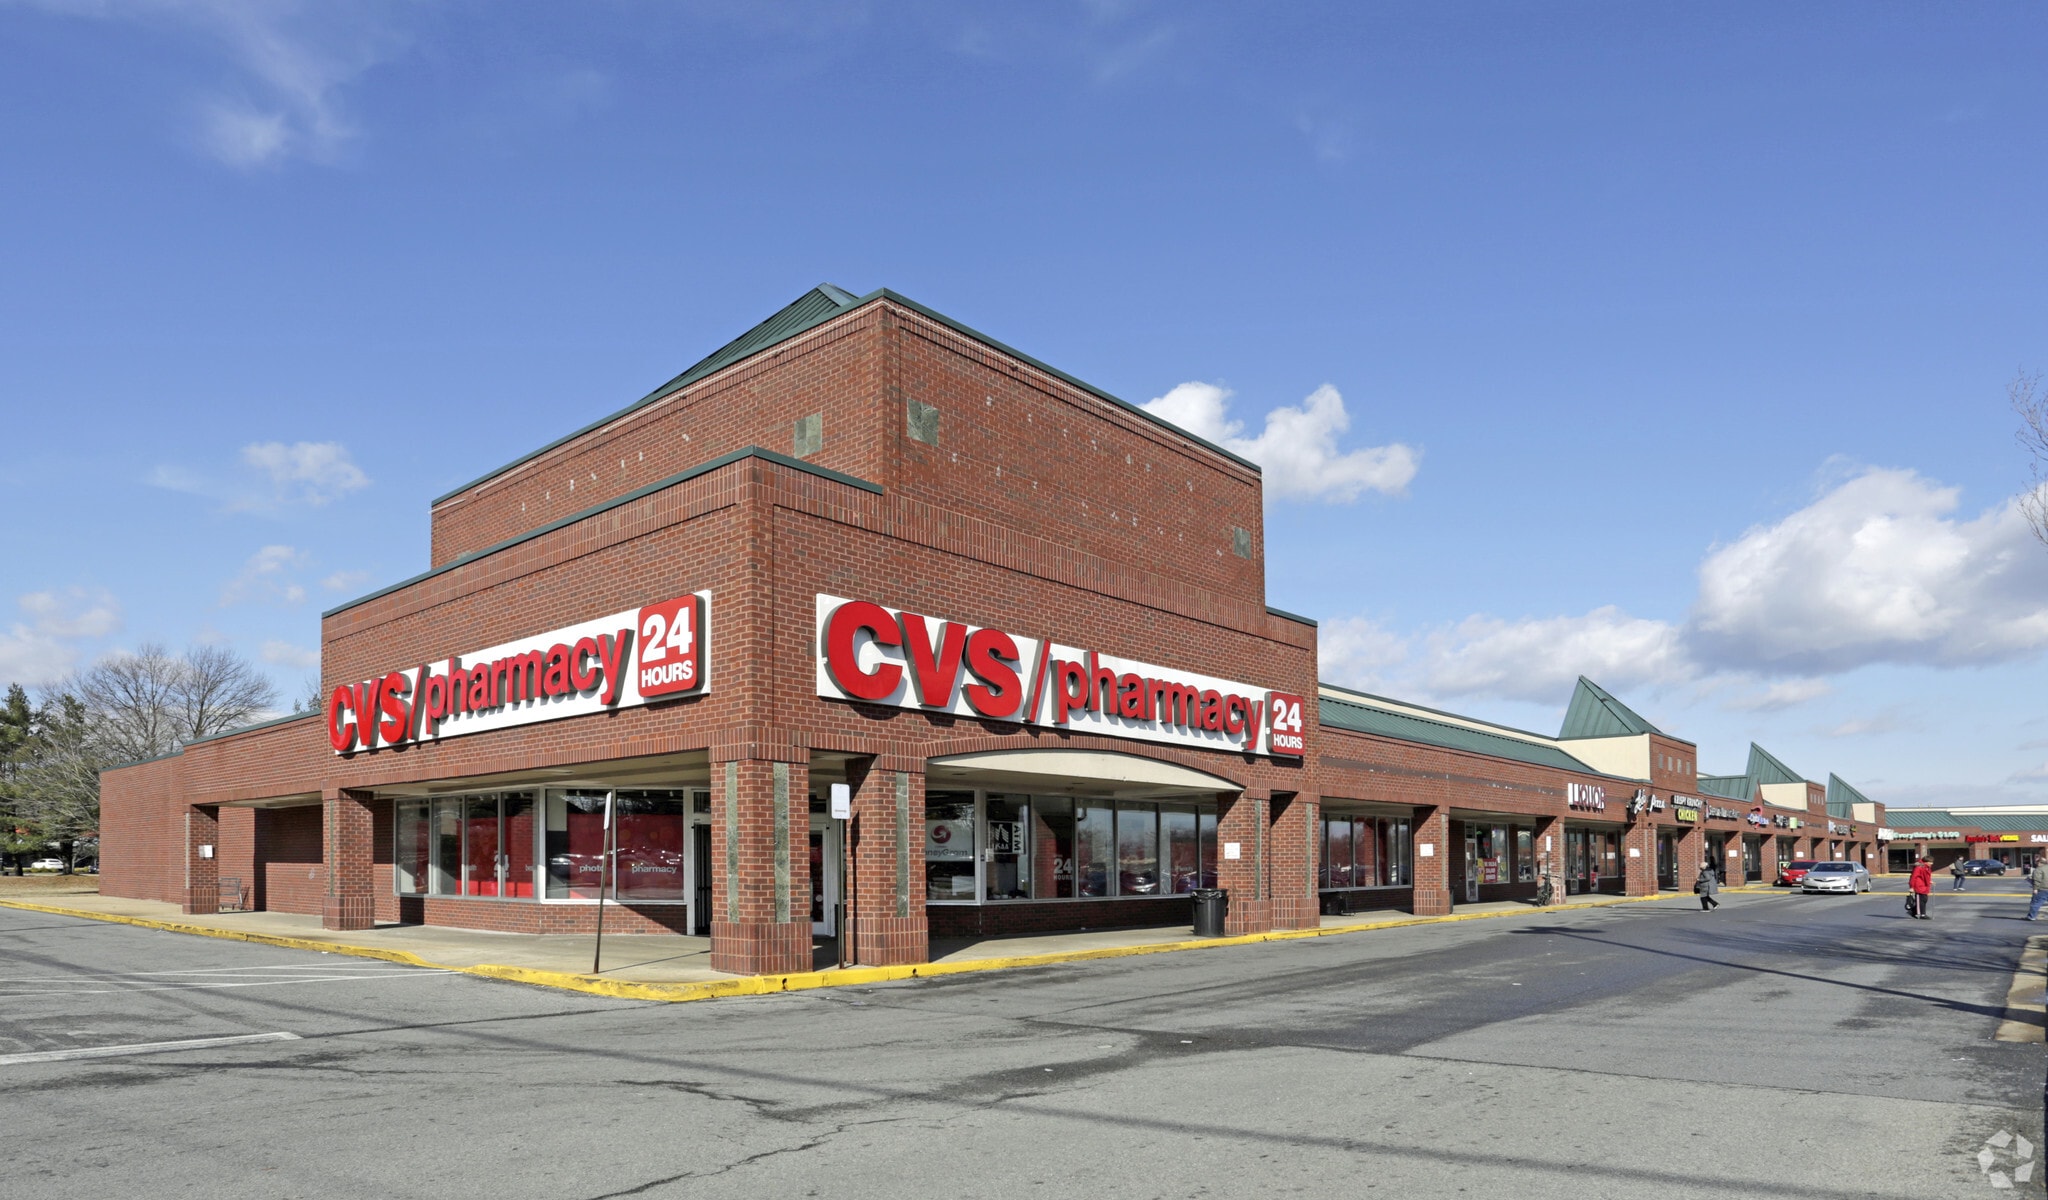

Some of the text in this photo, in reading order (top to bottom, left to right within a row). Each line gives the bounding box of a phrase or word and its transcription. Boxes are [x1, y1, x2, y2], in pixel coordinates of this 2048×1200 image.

[641, 606, 693, 663] 24
[641, 660, 693, 688] HOURS
[825, 600, 1263, 751] CVS/pharmacy
[329, 628, 634, 752] CVS/pharmacy
[1272, 698, 1302, 733] 24
[1273, 735, 1303, 750] HOURS
[1678, 808, 1698, 821] CHICKEN
[1013, 825, 1022, 852] ATM
[926, 848, 968, 857] neyGram
[1053, 858, 1073, 874] 24
[632, 864, 677, 874] pharmacy
